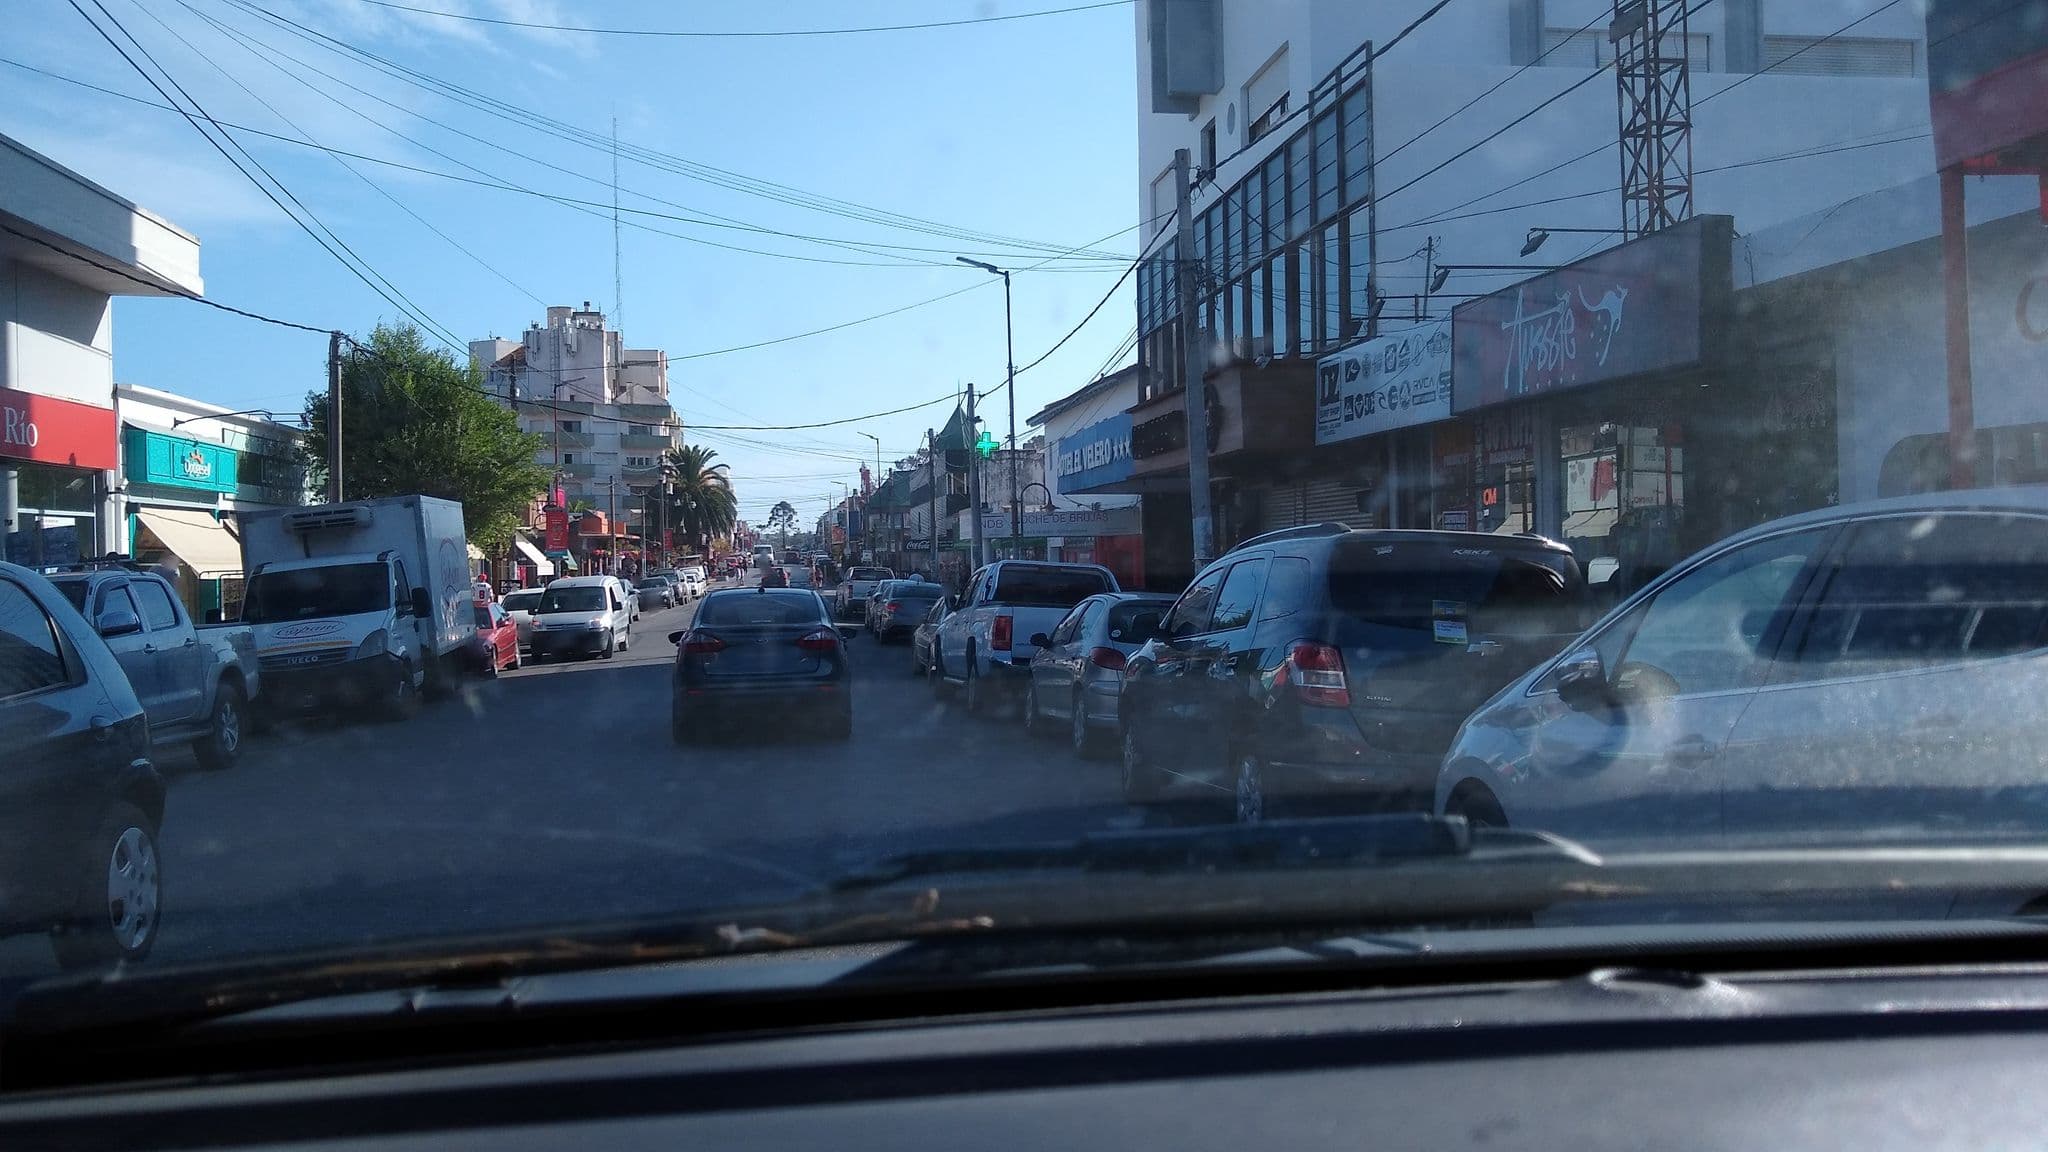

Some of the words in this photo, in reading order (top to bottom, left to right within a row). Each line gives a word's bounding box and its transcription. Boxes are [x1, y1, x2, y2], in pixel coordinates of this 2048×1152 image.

[3, 407, 39, 447] Río
[1083, 438, 1111, 471] VELERO
[1052, 511, 1066, 523] DE
[1069, 510, 1109, 523] BRUJAS
[288, 655, 319, 665] IVECO
